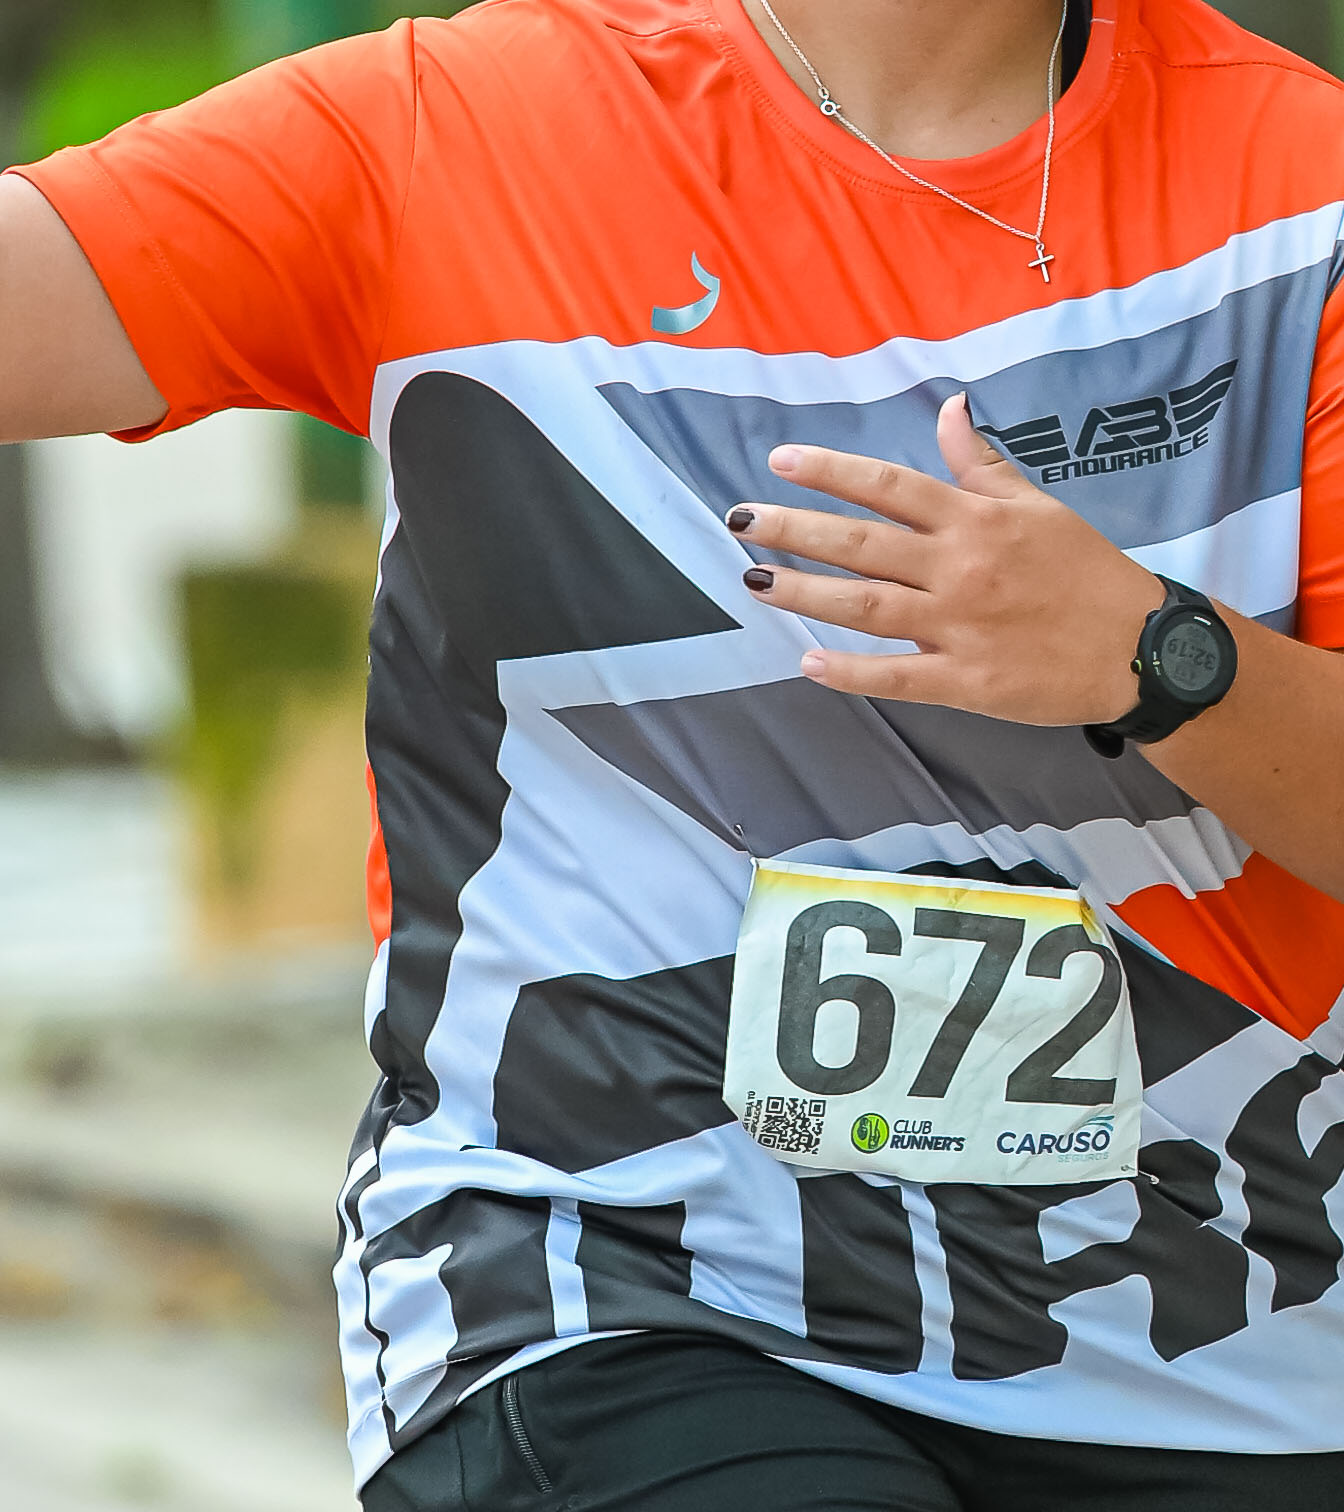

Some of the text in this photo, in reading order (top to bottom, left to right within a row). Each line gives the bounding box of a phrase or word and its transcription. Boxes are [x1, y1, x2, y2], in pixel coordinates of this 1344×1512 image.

[1040, 426, 1209, 485] ENDURANCE
[776, 899, 1123, 1105] 672
[893, 1119, 933, 1135] CLUB
[889, 1134, 967, 1152] RUNNER'S
[996, 1129, 1111, 1155] CARUSO
[1057, 1152, 1110, 1163] SEGUROS
